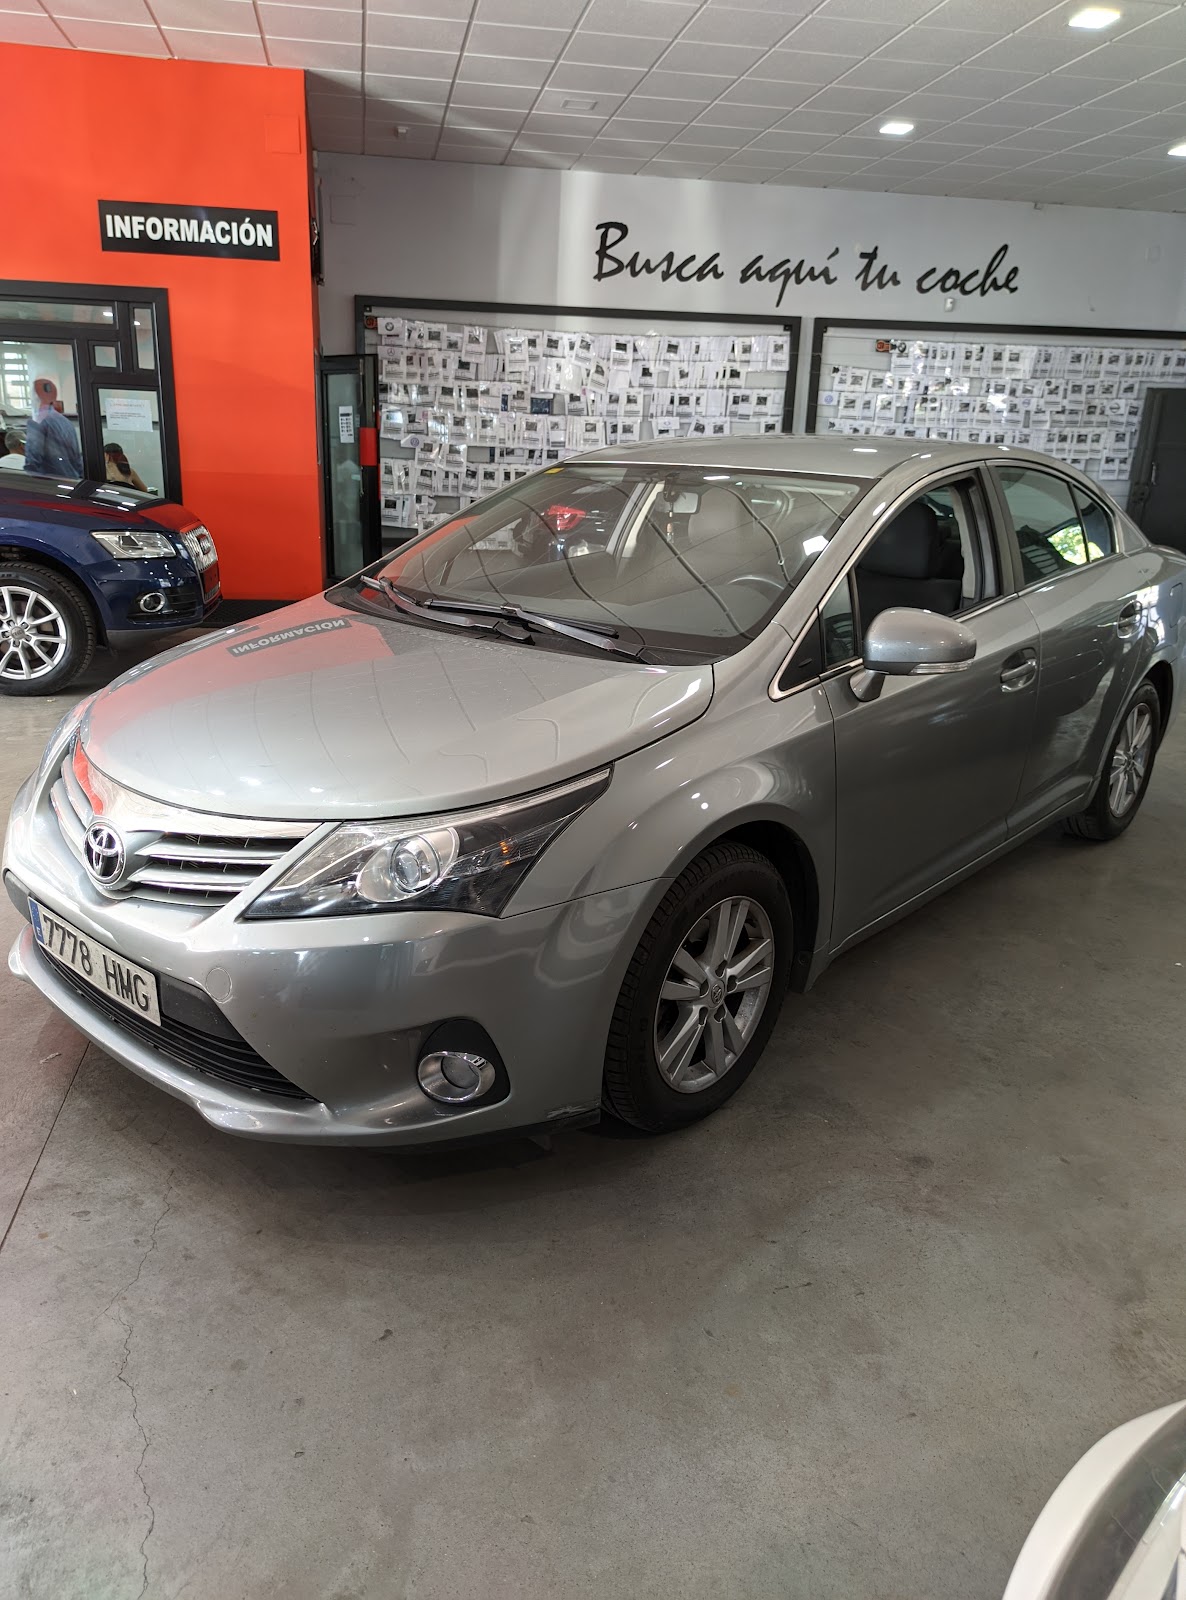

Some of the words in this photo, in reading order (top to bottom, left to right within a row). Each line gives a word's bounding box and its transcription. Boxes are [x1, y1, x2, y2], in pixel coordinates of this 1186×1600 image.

[105, 214, 273, 247] INFORMACIÓN
[593, 221, 724, 282] Busca
[739, 247, 839, 307] aquí
[855, 245, 900, 291] tu
[916, 244, 1018, 297] coche
[43, 913, 93, 976] 7778
[102, 953, 150, 1011] HMG
